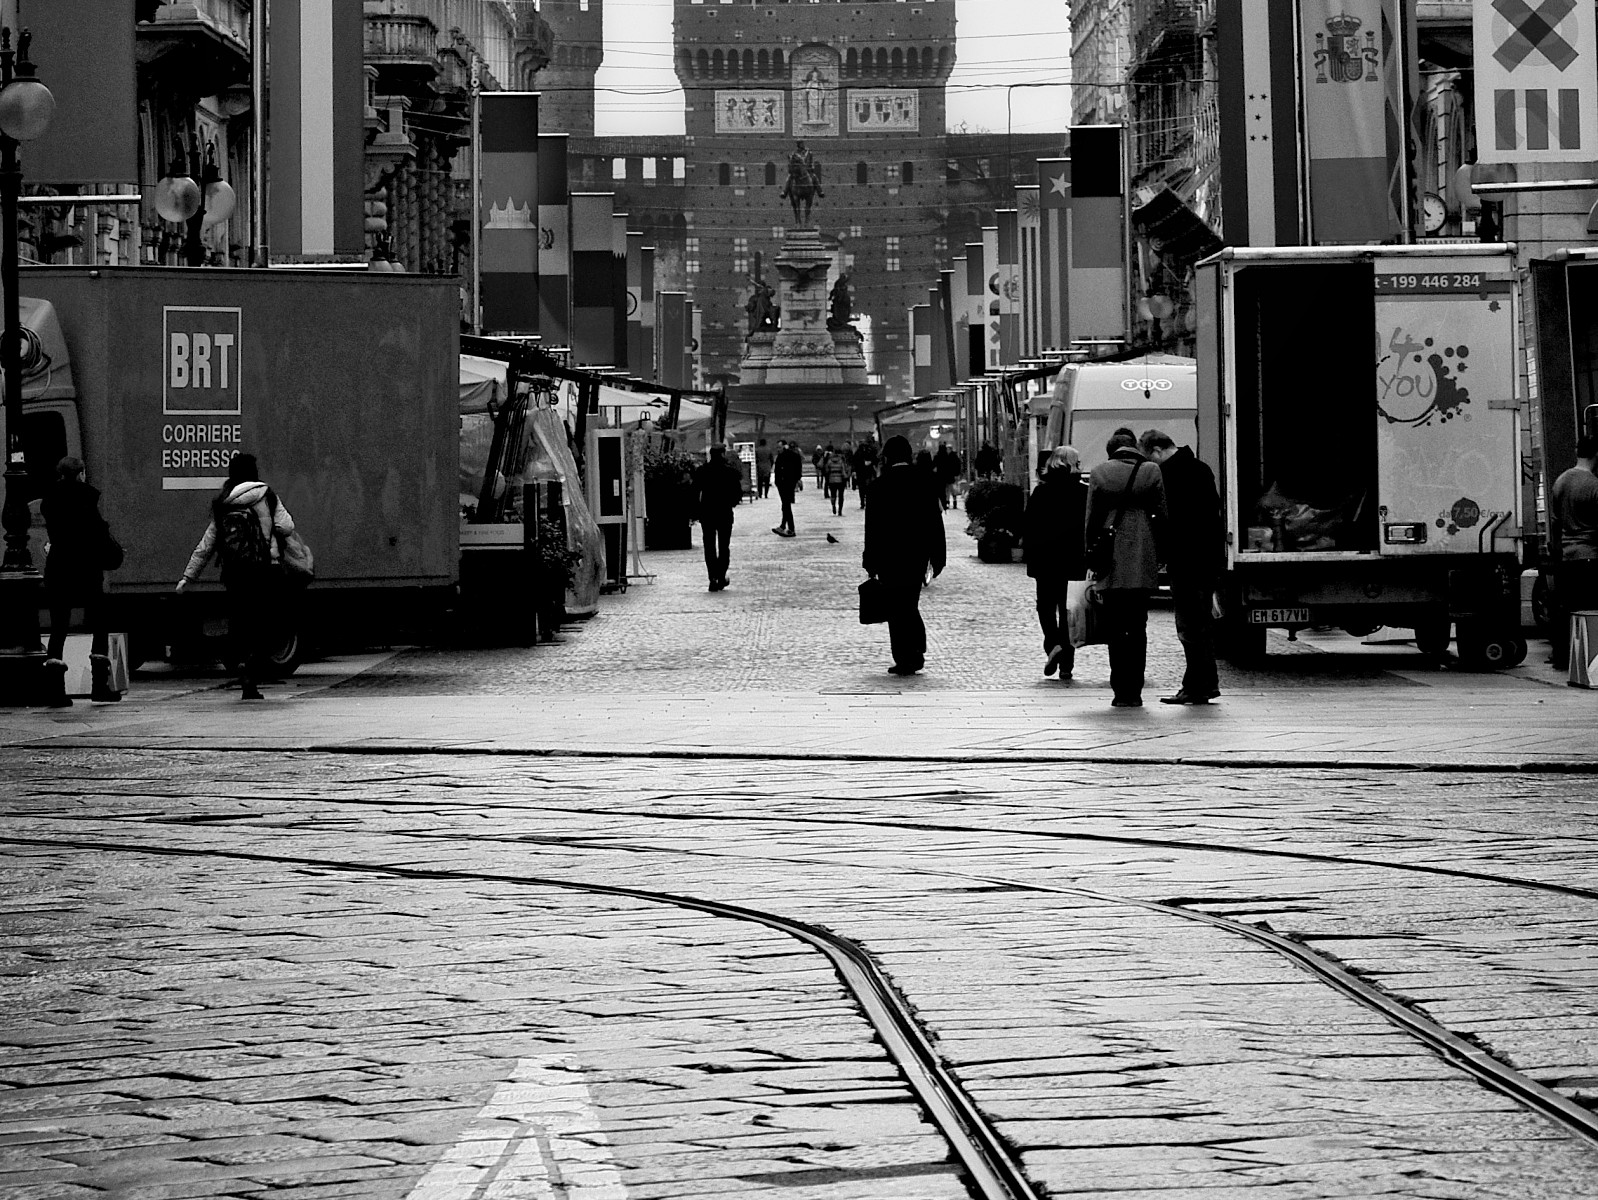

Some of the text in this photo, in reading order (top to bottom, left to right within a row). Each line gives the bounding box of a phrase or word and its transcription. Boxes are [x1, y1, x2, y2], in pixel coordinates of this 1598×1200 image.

[1421, 275, 1449, 288] 446
[1453, 275, 1480, 287] 284
[171, 332, 234, 389] BRT
[1122, 379, 1171, 390] TNT
[1379, 374, 1434, 399] YOU
[162, 424, 242, 443] CORRIERE
